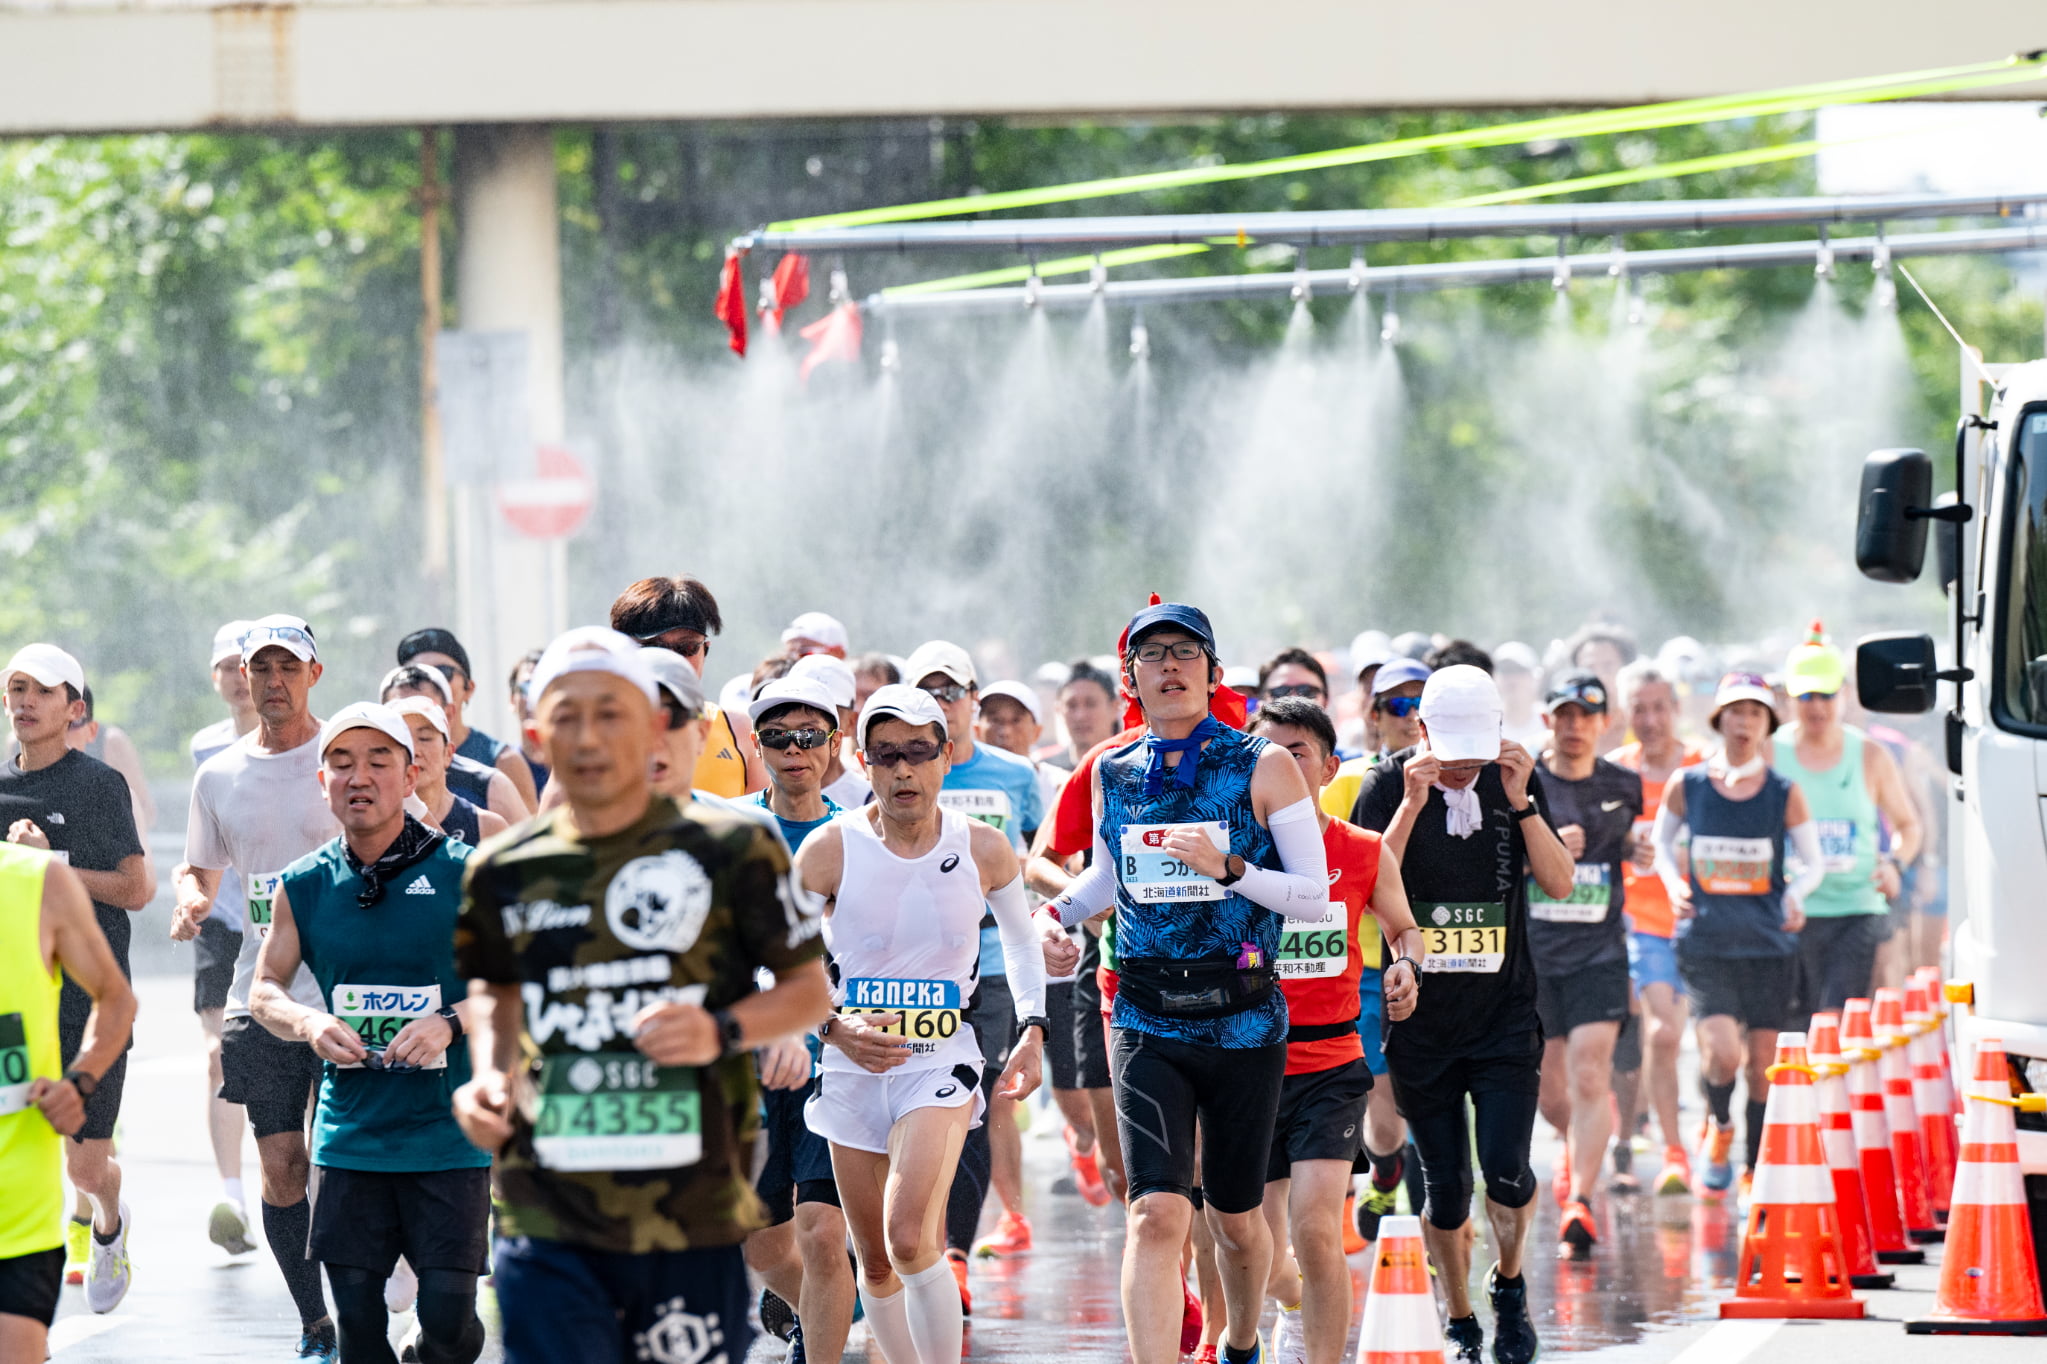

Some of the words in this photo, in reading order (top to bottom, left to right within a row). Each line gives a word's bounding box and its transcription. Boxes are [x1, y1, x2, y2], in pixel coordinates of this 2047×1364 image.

[1495, 826, 1512, 891] PUMA
[405, 887, 436, 895] adidas
[1143, 885, 1210, 898] 北海道新聞社
[1454, 908, 1485, 922] SGC
[1278, 930, 1344, 959] 466
[362, 992, 430, 1012] ホクレン
[605, 1060, 658, 1089] SGC
